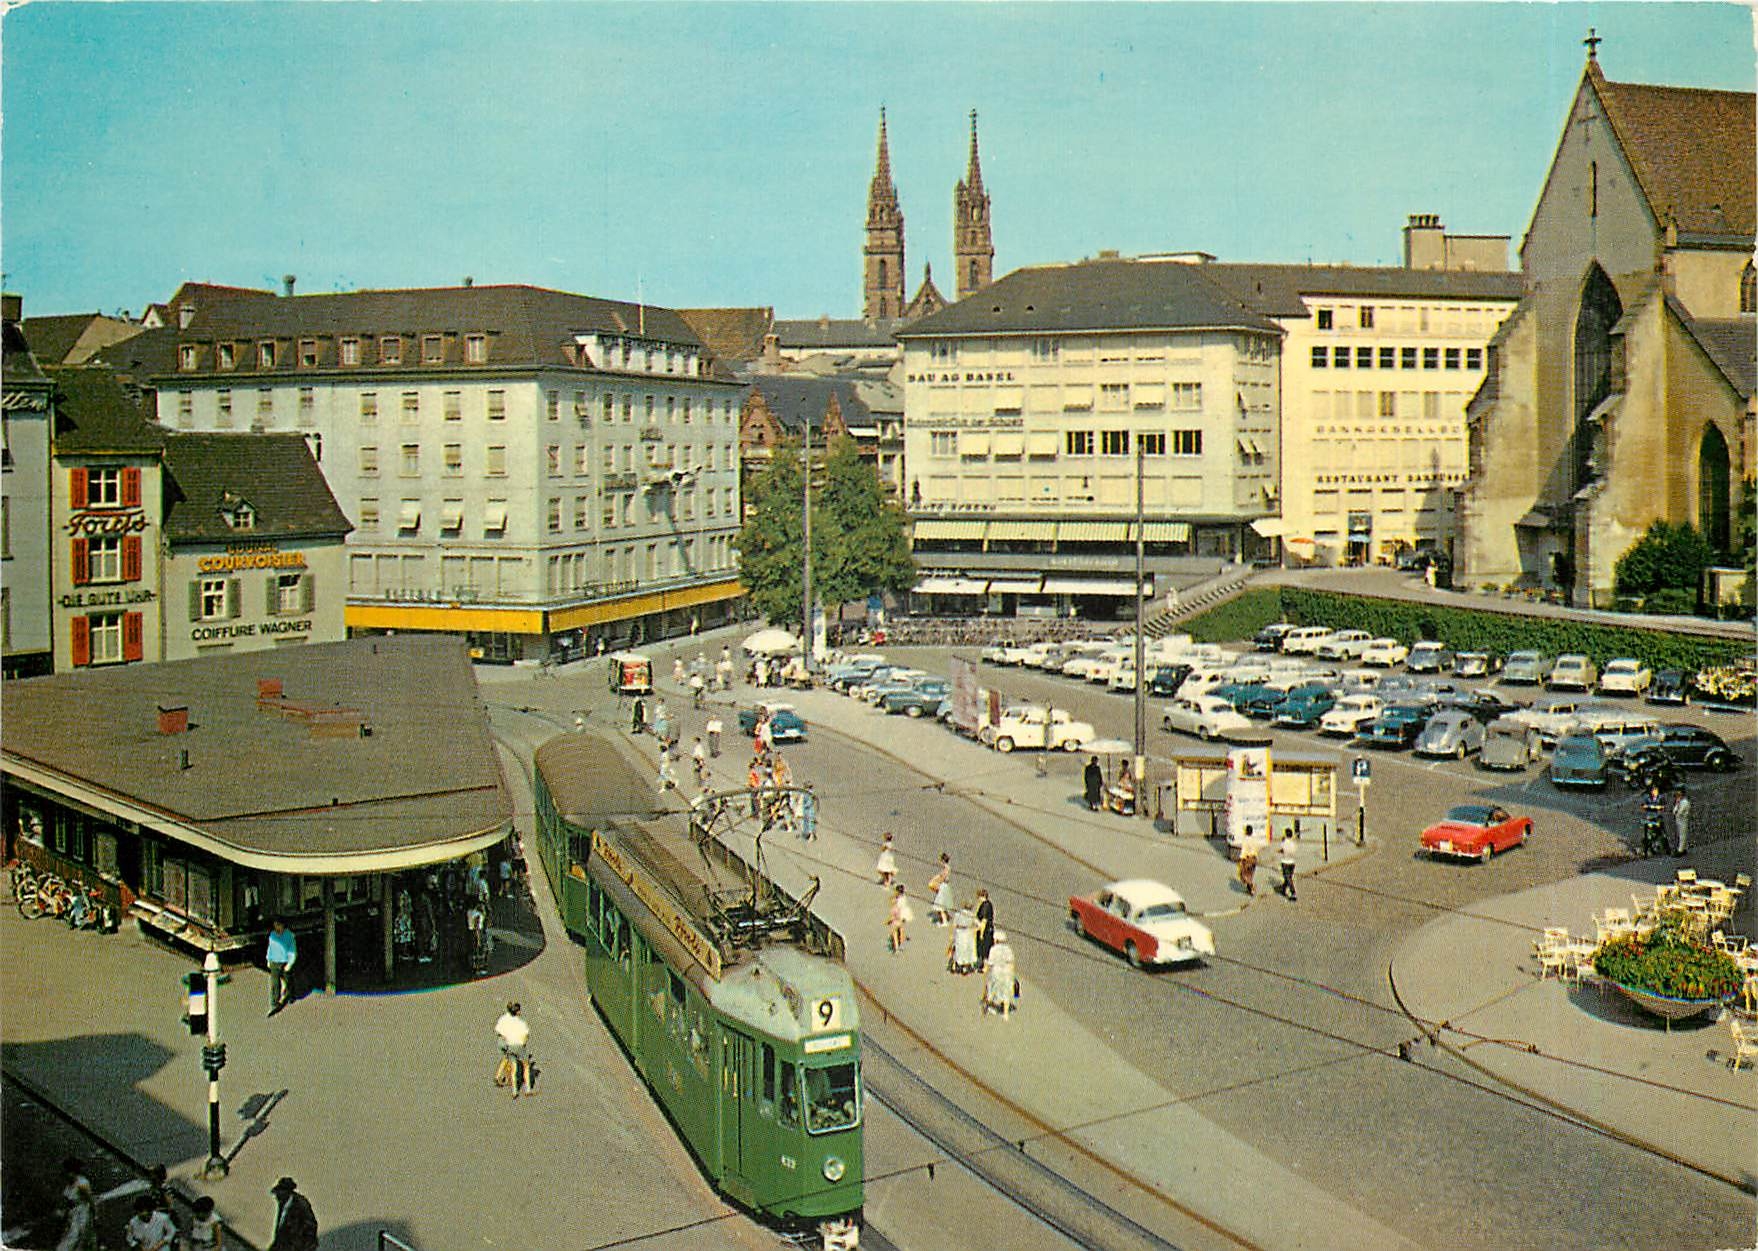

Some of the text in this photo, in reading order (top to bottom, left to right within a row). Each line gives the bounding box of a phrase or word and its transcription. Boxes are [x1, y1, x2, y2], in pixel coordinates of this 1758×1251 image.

[907, 372, 1015, 383] BAU AG BASEL
[1316, 475, 1398, 483] RESTAURANT
[197, 551, 306, 572] COURVOISIER
[62, 594, 83, 608] DIE
[88, 591, 121, 606] GUTE
[191, 620, 313, 641] COIFFURE WAGNER
[1356, 759, 1367, 775] P
[818, 999, 833, 1026] 9
